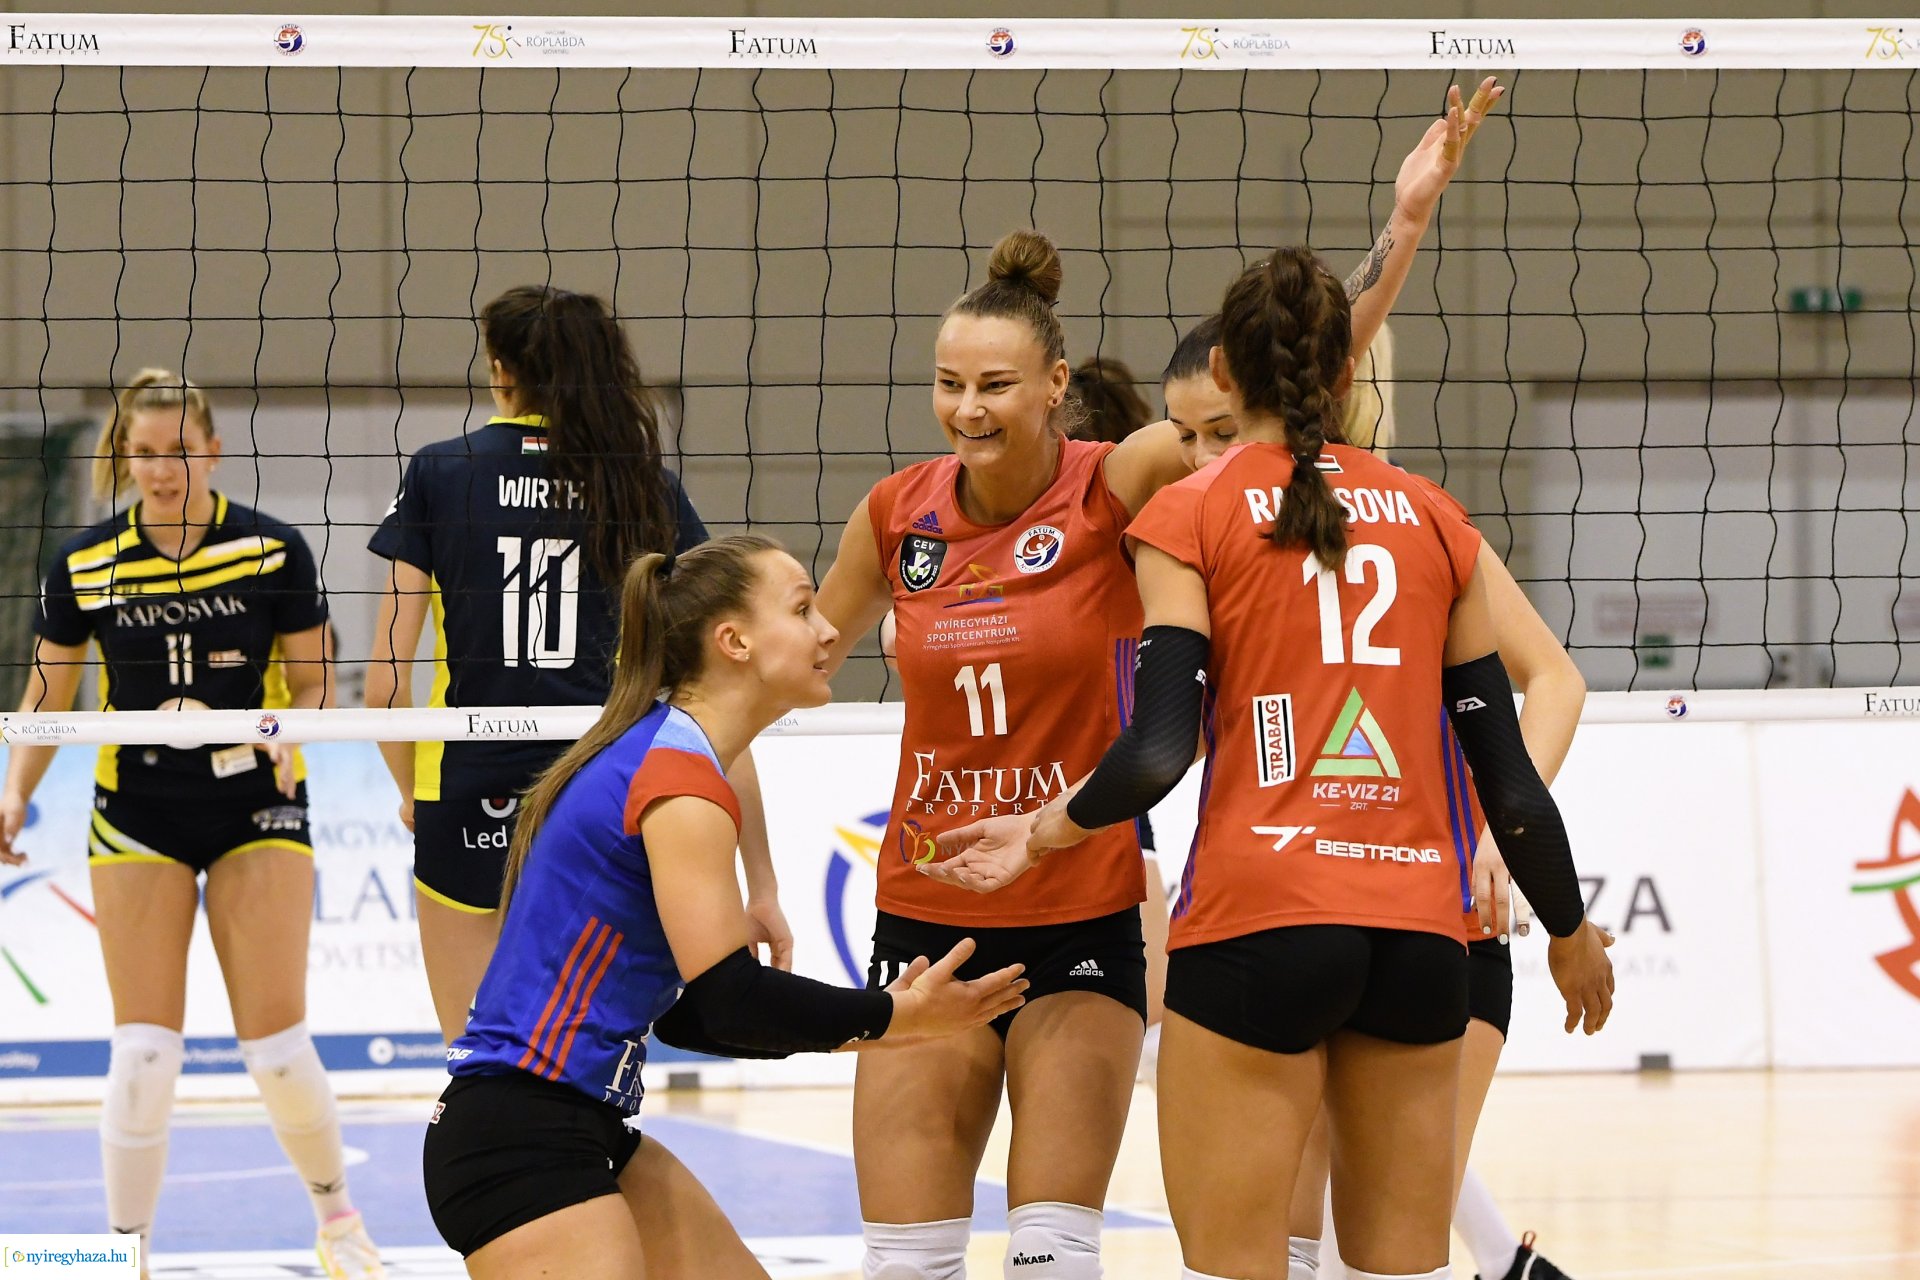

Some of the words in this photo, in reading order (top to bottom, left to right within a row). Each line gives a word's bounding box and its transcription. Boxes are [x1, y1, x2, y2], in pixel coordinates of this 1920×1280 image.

[1243, 486, 1421, 526] RASOVA
[913, 539, 936, 551] CEV
[497, 536, 581, 669] 10
[1302, 543, 1401, 666] 12
[926, 626, 1017, 643] SPORTCENTRUM
[934, 615, 1008, 630] NYÍREGYHÁZI
[165, 633, 193, 685] 11
[954, 663, 1007, 737] 11
[1265, 699, 1285, 781] STRABAG
[1312, 782, 1378, 801] KE-VIZ
[1380, 785, 1400, 803] 21
[462, 824, 508, 849] Led
[1315, 838, 1441, 863] BESTRONG
[1069, 967, 1104, 977] adidas
